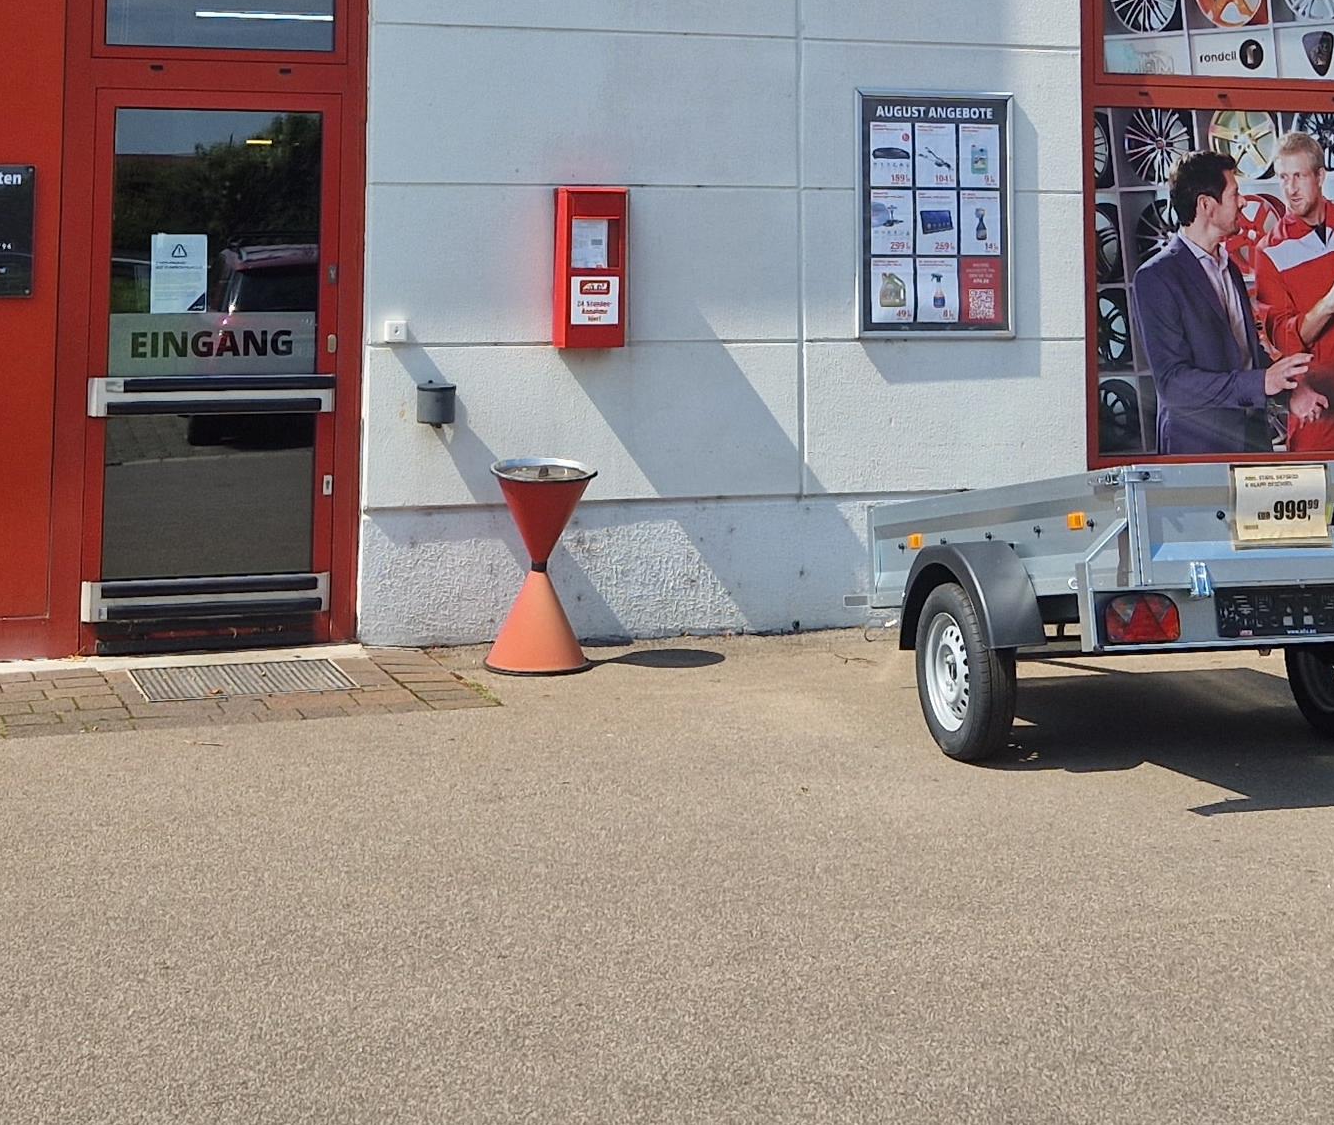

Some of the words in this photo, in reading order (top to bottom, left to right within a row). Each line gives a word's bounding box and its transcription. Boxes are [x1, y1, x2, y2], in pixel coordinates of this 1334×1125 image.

[876, 105, 926, 117] AUGUST
[928, 106, 993, 119] ANGEBOTE
[131, 330, 294, 359] EINGANG
